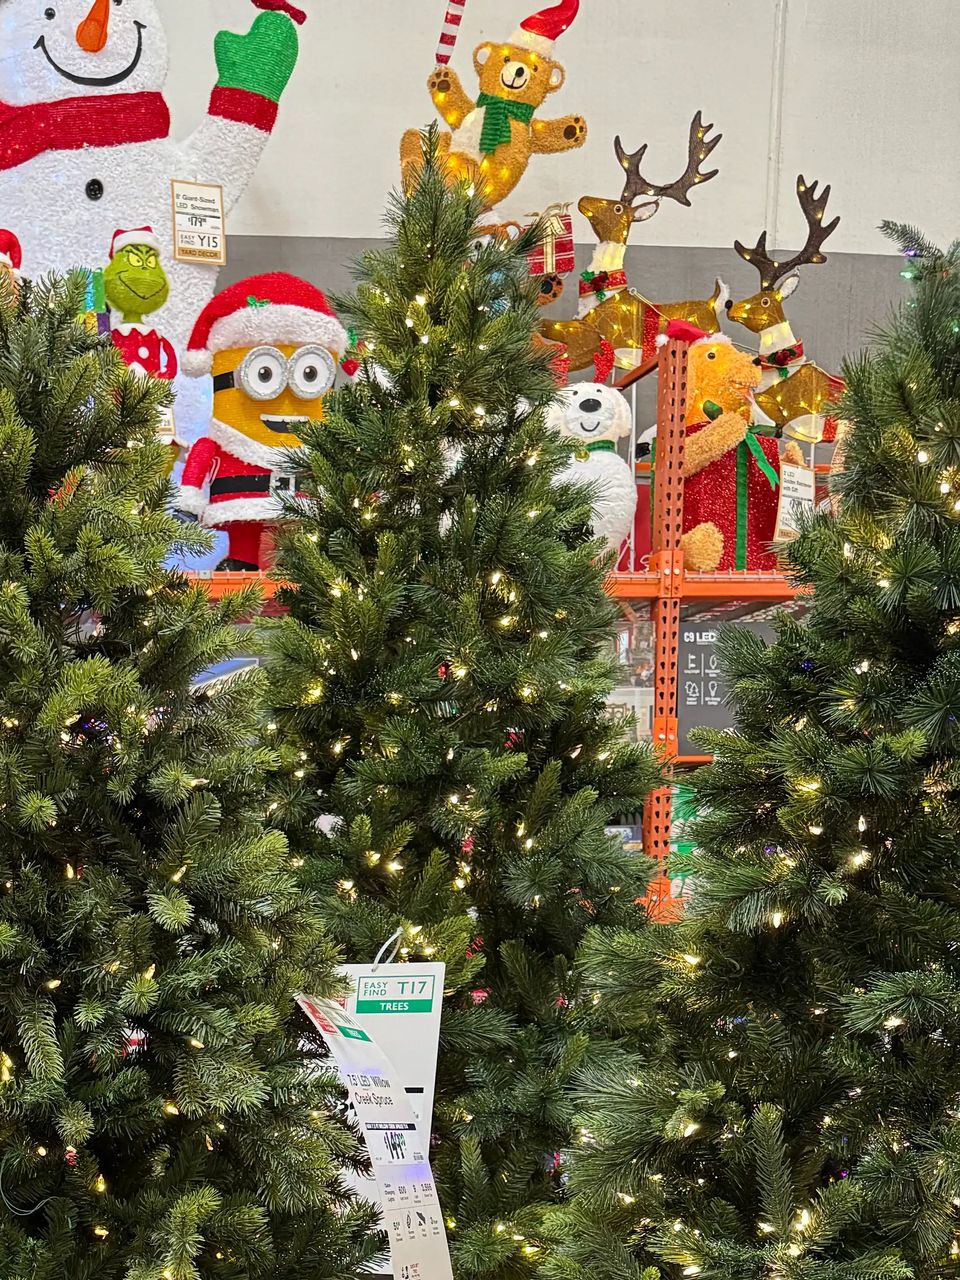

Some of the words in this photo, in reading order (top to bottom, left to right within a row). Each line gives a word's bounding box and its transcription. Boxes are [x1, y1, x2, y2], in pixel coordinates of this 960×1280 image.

[198, 235, 218, 248] Y15
[397, 981, 427, 994] T17
[380, 1002, 409, 1011] TREES
